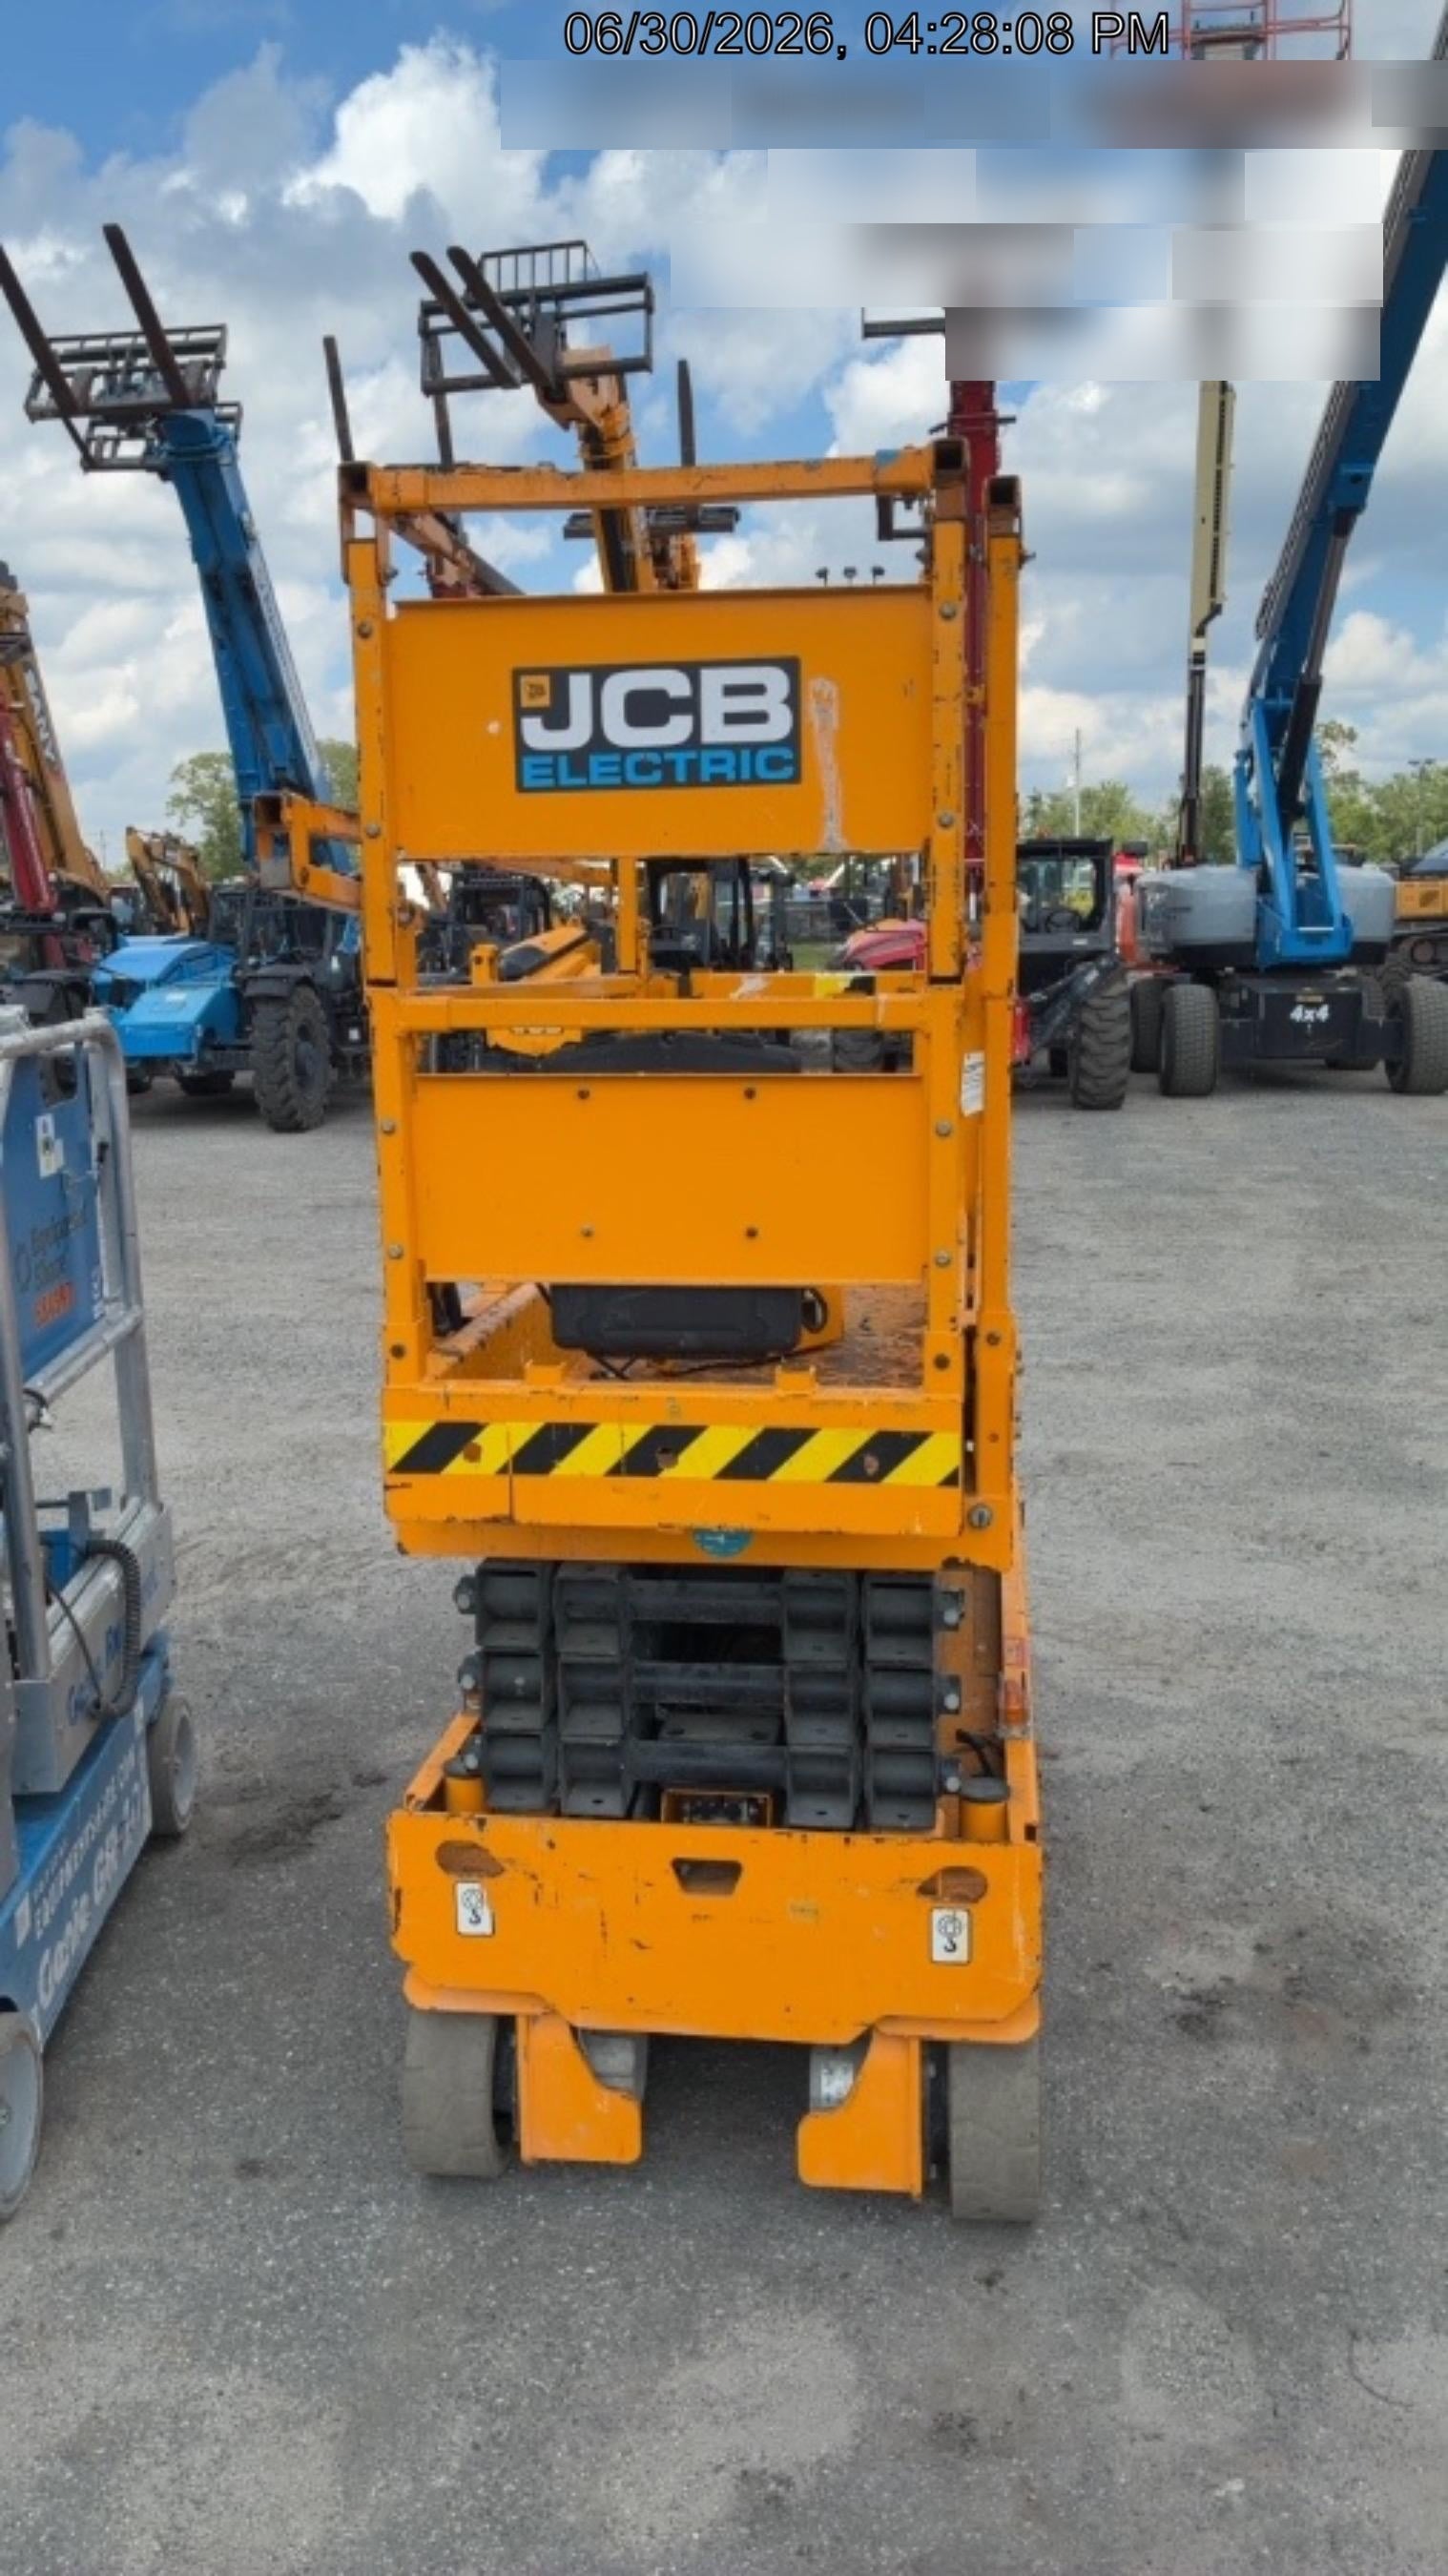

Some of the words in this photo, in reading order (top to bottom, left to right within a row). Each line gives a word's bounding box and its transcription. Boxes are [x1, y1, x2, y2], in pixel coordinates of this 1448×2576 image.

[520, 665, 794, 751] JCB
[523, 746, 795, 788] ELECTRIC
[1290, 1004, 1329, 1023] 4x4
